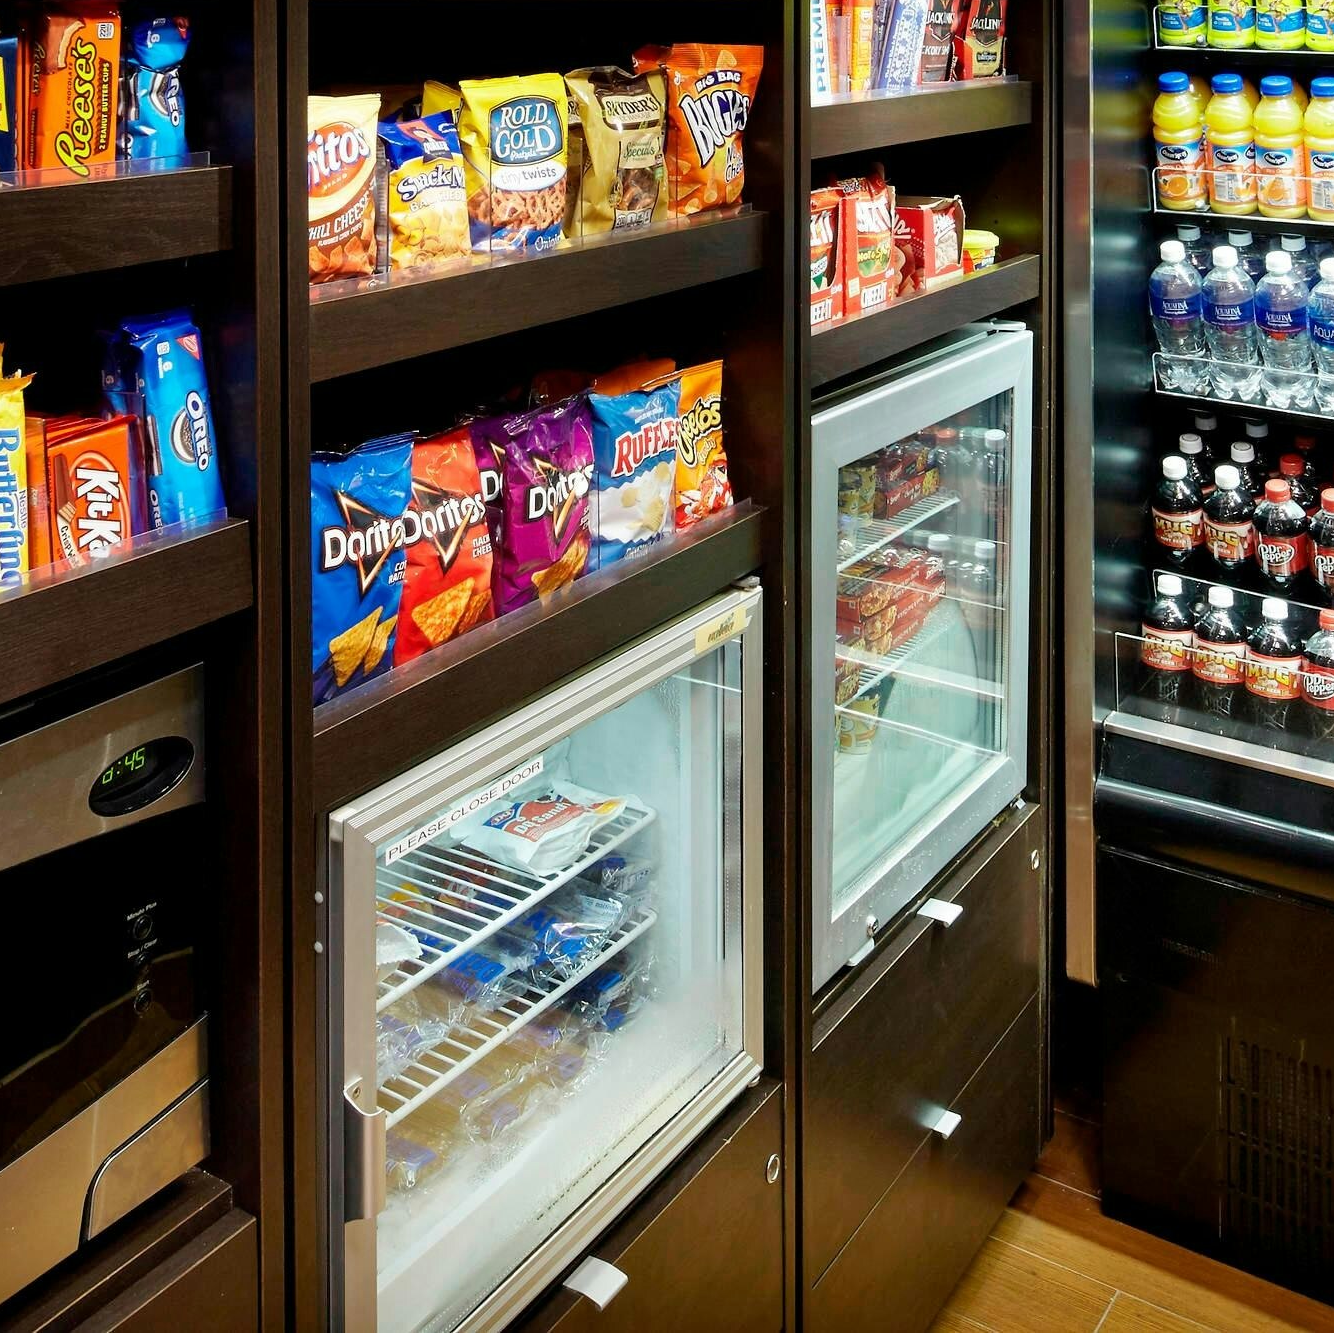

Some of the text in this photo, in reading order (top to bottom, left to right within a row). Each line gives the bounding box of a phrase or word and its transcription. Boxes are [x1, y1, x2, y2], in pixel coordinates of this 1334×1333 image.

[695, 70, 742, 93] BIG BAG
[55, 37, 98, 179] Reese's
[500, 102, 549, 128] ROLD
[605, 95, 660, 118] SNYDER'S
[495, 123, 558, 158] GOLD
[521, 166, 558, 182] twists
[185, 389, 212, 472] OREO
[403, 492, 487, 547] Doritos
[1153, 516, 1194, 536] MUG
[1246, 664, 1290, 686] MUG
[387, 760, 542, 860] PLEASE CLOSE DOOR
